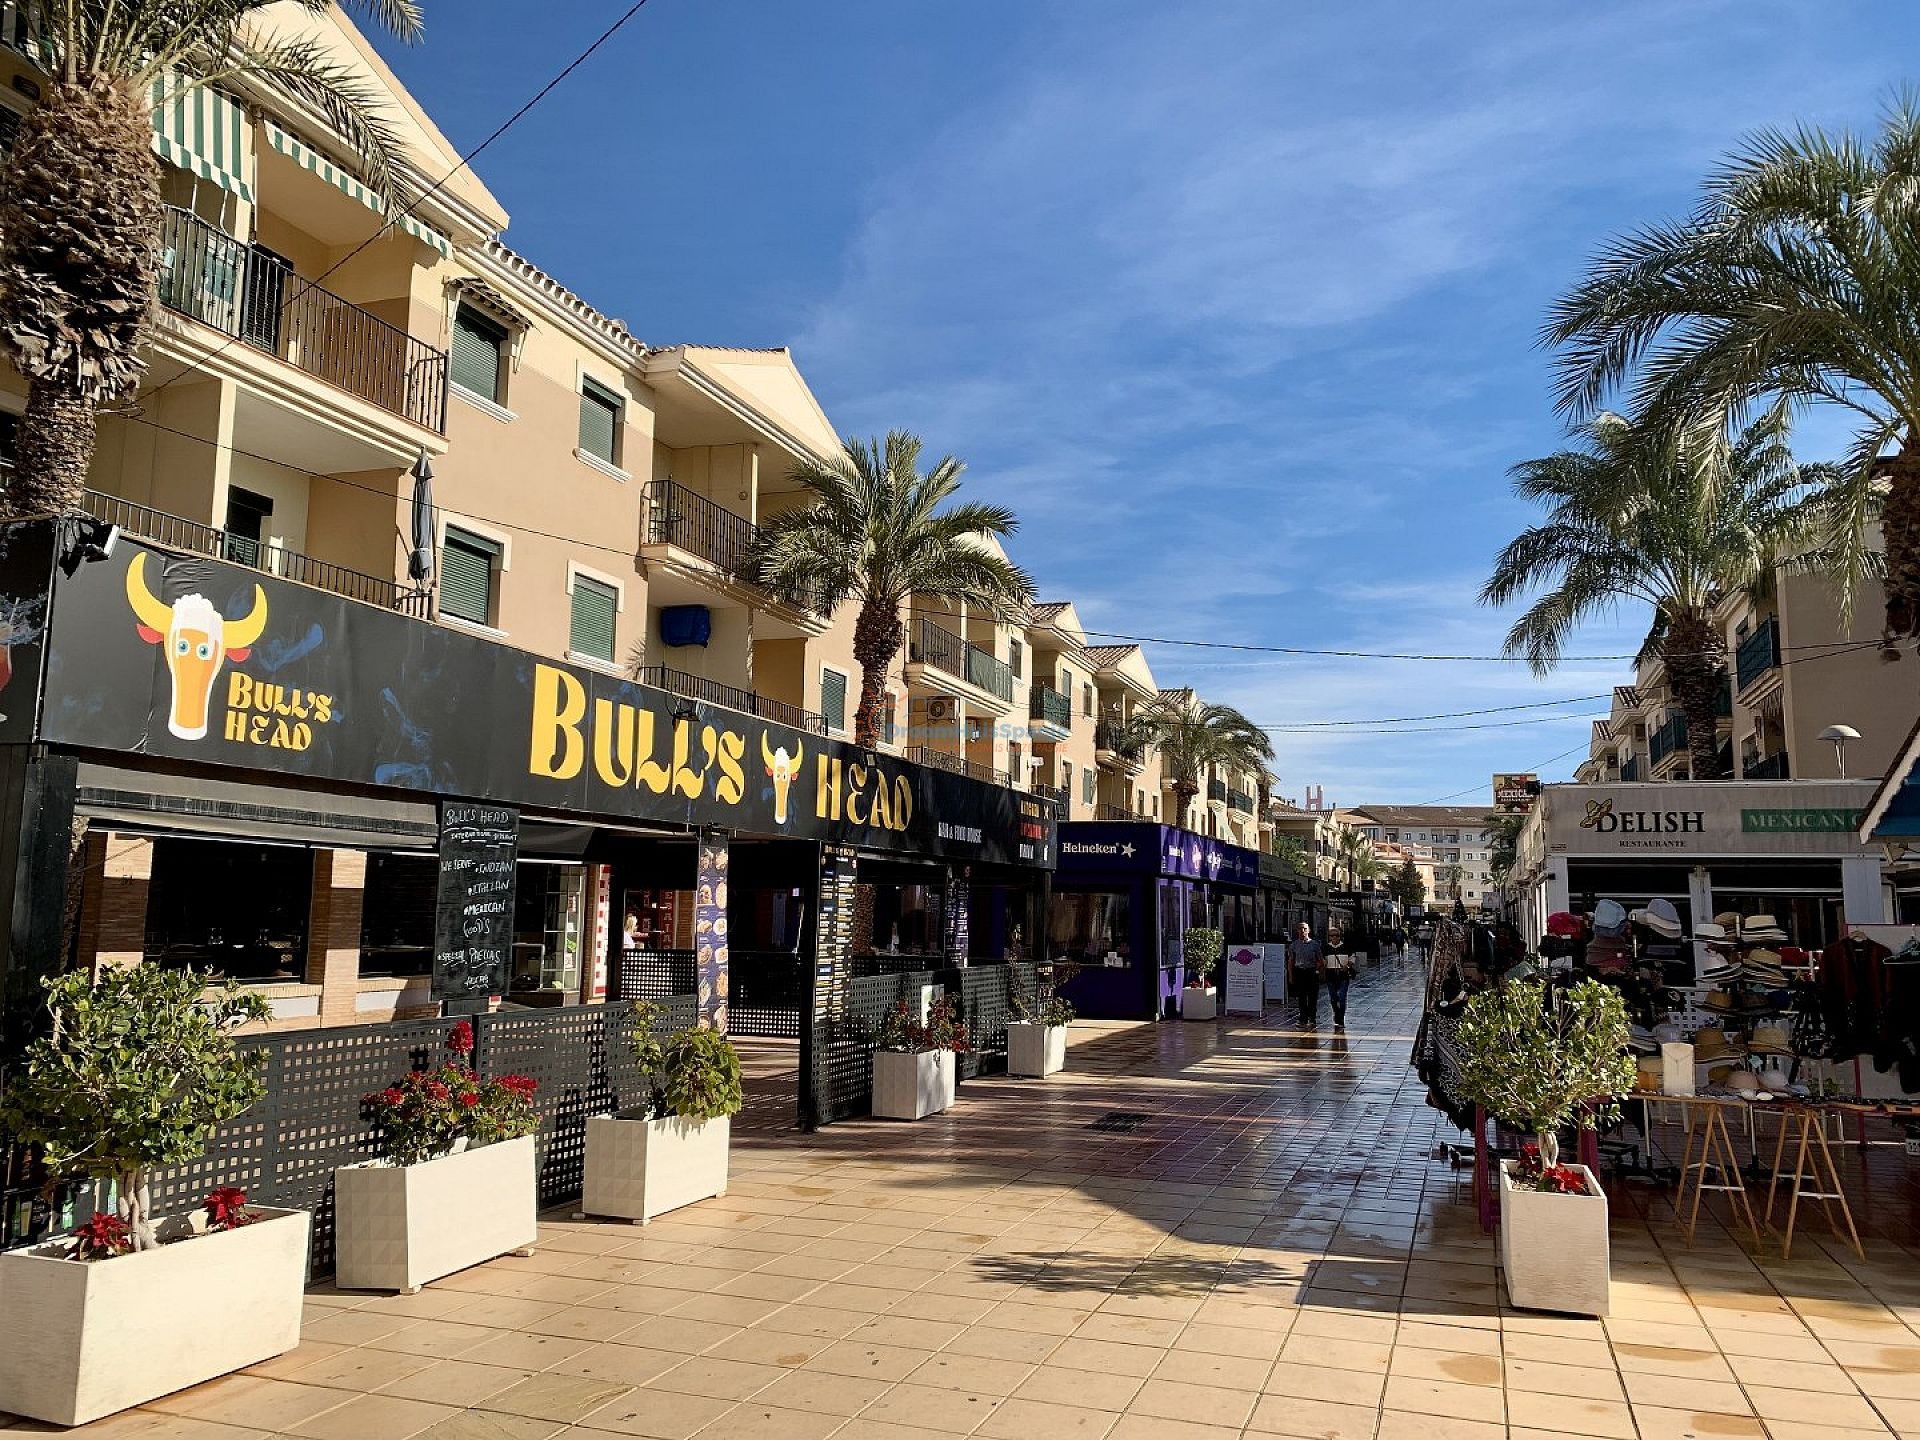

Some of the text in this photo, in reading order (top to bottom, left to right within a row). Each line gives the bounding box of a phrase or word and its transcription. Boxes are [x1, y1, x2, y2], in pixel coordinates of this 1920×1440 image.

[228, 671, 333, 723] BULL'S
[224, 710, 312, 752] HEAD
[529, 663, 913, 832] BULL'S HEAD
[480, 810, 509, 825] HEAD
[1594, 811, 1706, 833] DELISH
[1749, 814, 1845, 828] MEXICAN
[1062, 842, 1117, 854] Heineken
[1619, 840, 1687, 848] RESTAURANTE
